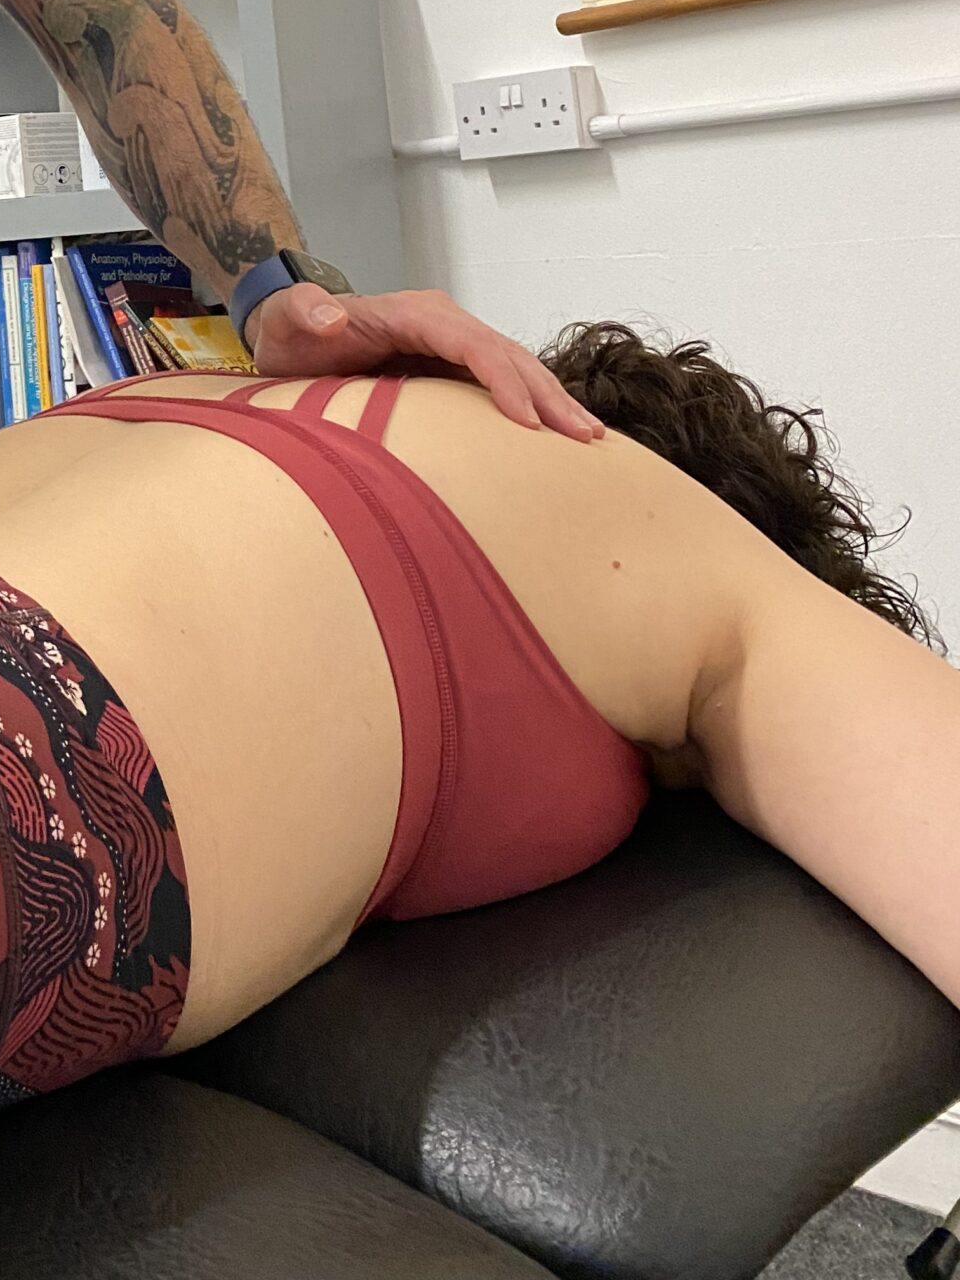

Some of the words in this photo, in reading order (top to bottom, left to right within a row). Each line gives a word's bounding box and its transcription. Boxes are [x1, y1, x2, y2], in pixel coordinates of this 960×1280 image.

[91, 252, 131, 268] Anatomy,
[132, 252, 178, 268] Physiology
[101, 270, 117, 281] and
[118, 269, 158, 284] Pathology
[159, 269, 171, 283] for
[24, 322, 32, 340] and
[26, 341, 35, 384] Treatment
